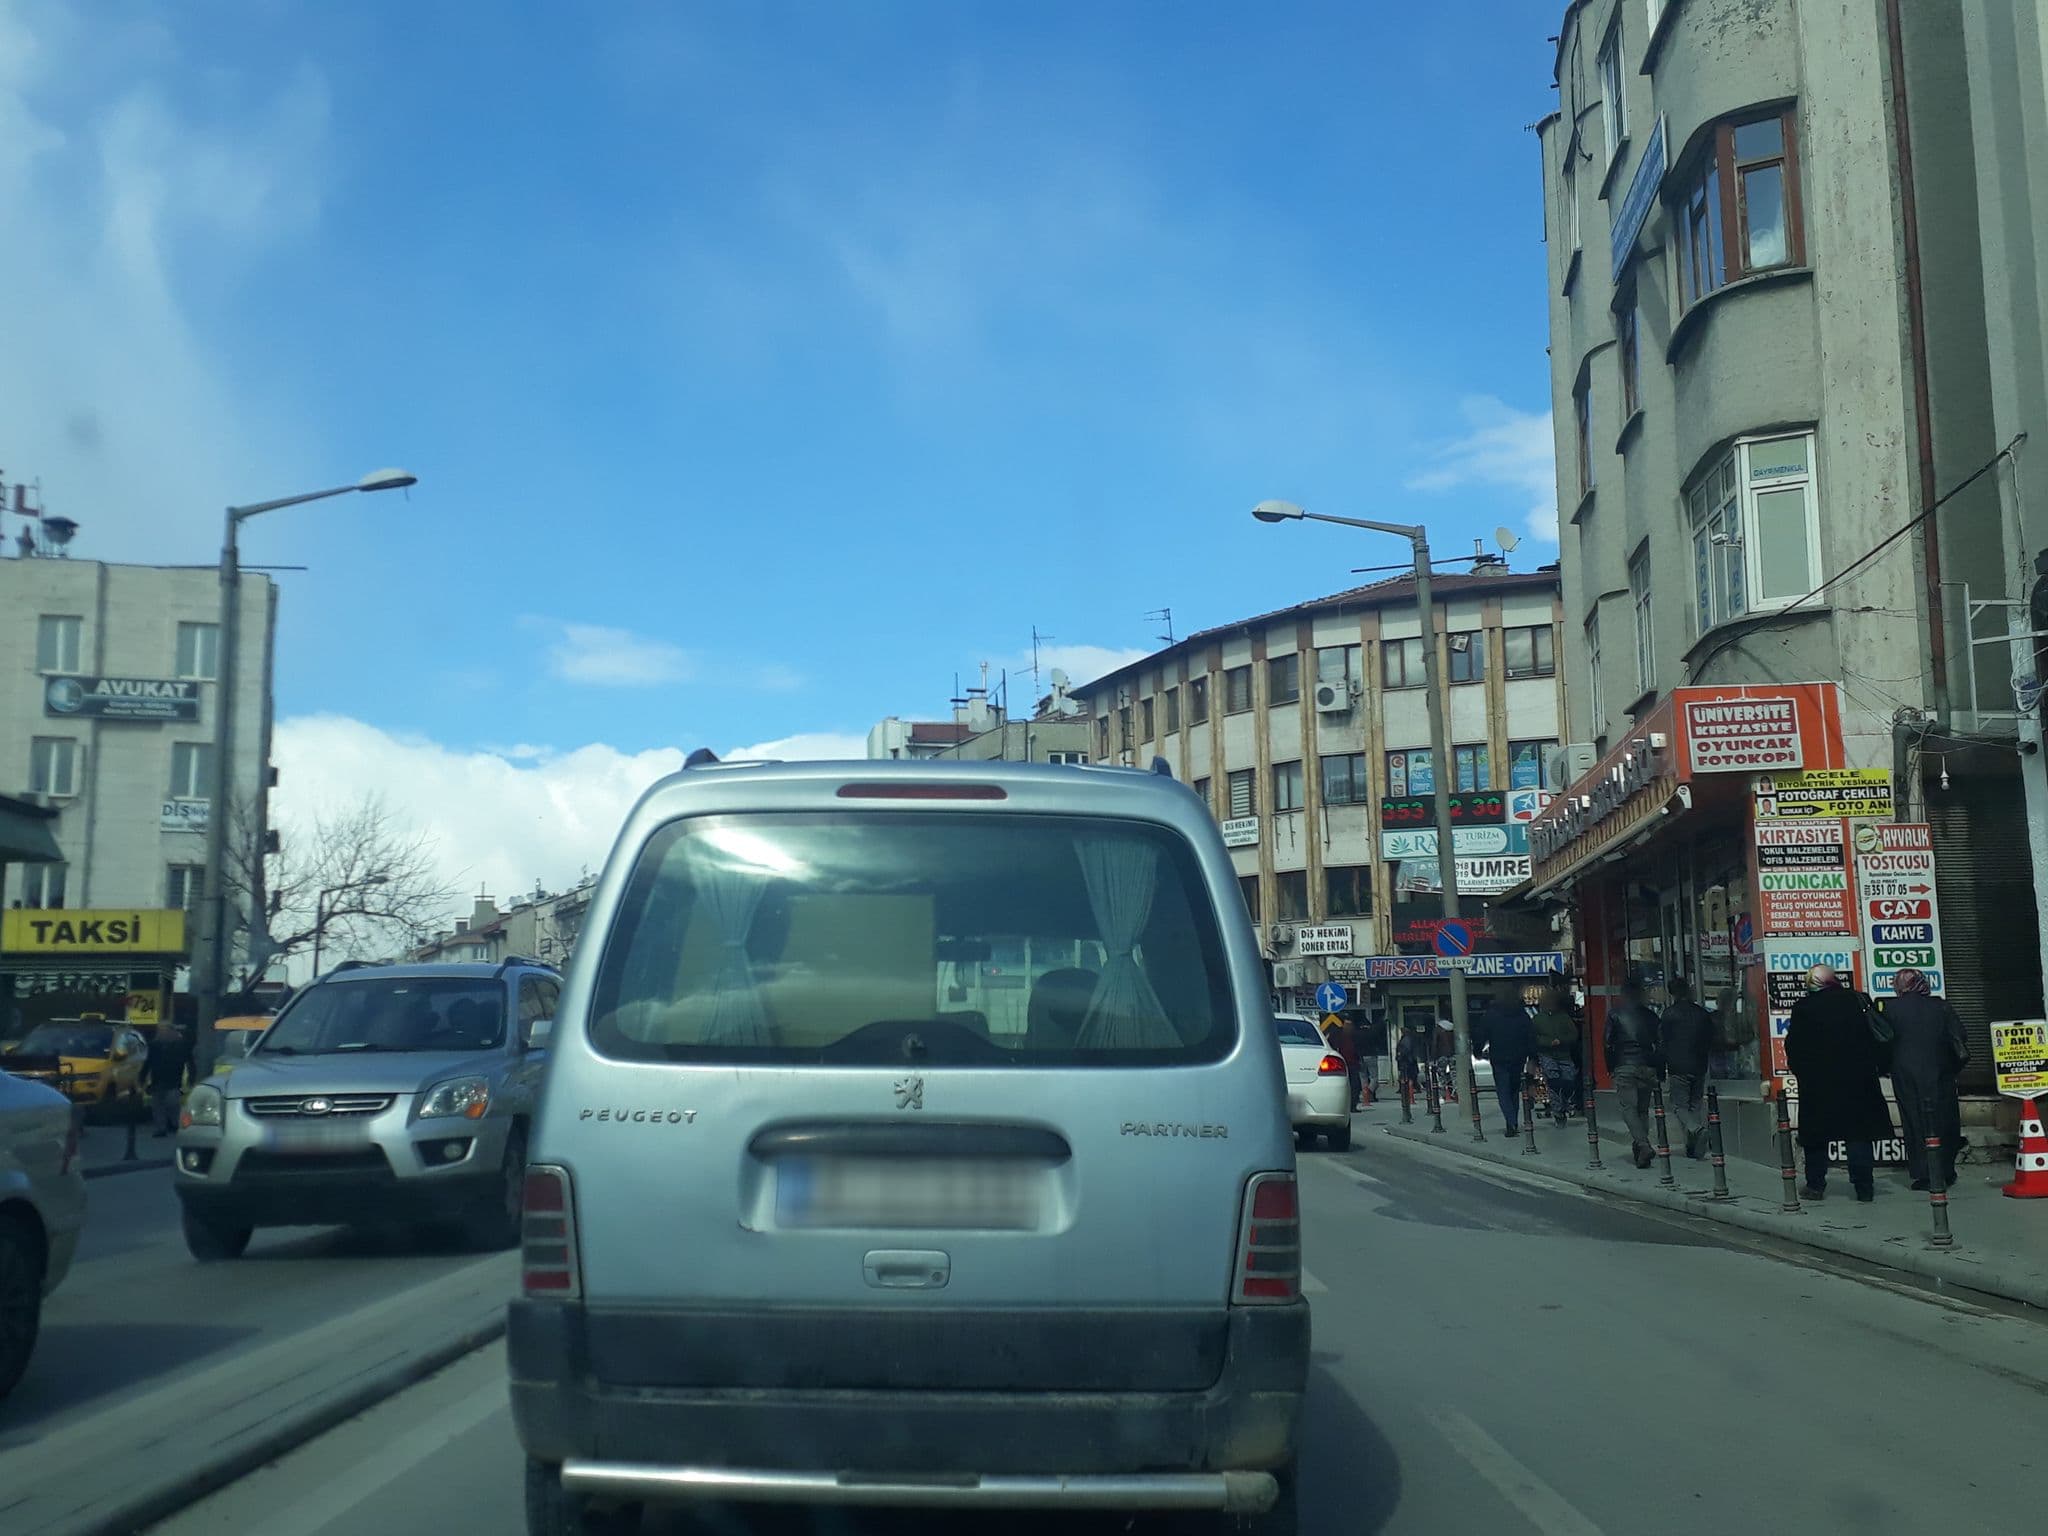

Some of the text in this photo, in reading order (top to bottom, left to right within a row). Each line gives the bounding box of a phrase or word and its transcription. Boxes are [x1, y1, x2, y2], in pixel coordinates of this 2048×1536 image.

[95, 679, 189, 697] AVUKAT
[1693, 703, 1791, 723] ÜNİVERSİTE
[1695, 722, 1792, 735] KIRTASİYE
[1697, 738, 1792, 752] OYUNCAK
[1698, 751, 1796, 766] FOTOKOPİ
[1805, 771, 1860, 779] ACELE
[1777, 780, 1835, 789] BİYOMETRİK
[1778, 786, 1889, 802] FOTOĞRAF ÇEKİLİR
[1829, 800, 1892, 811] FOTO ANI
[1465, 831, 1500, 841] TURİZM
[1759, 828, 1840, 844] KIRTASİYE
[1883, 828, 1930, 848] AYVALIK
[1471, 860, 1530, 878] UMRE
[1862, 855, 1930, 870] TOSTCUSU
[1762, 873, 1844, 890] OYUNCAK
[1801, 892, 1842, 900] OYUNCAK
[1872, 884, 1885, 896] 351
[1887, 884, 1897, 895] 07
[1898, 883, 1908, 895] 05
[1794, 901, 1842, 909] OYUNCAKLAR
[1880, 900, 1920, 919] ÇAY
[30, 915, 140, 944] TAKSİ
[1880, 926, 1925, 941] KAHVE
[1301, 940, 1349, 952] SONER ERTAŞ
[1879, 950, 1931, 965] TOST
[2004, 1027, 2034, 1037] FOTO
[579, 1109, 698, 1124] PEUGEOT
[1120, 1122, 1229, 1139] PARTNER
